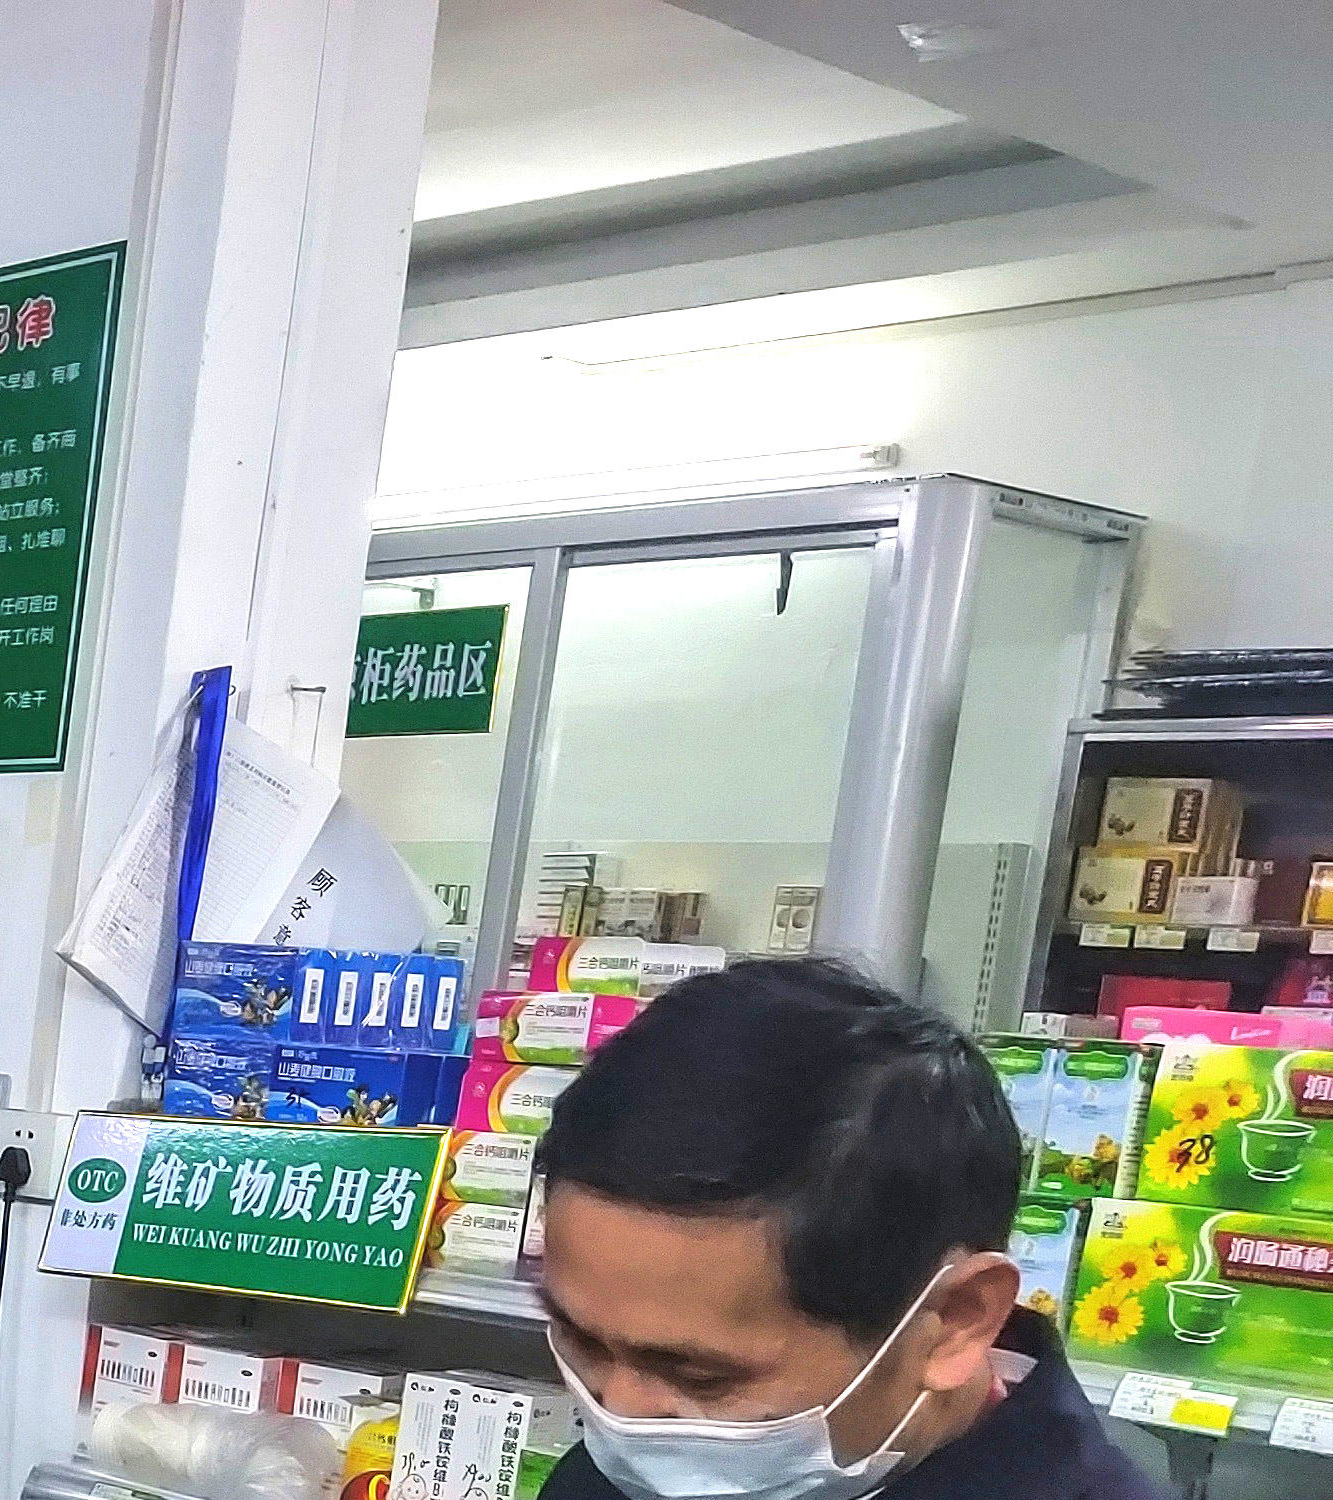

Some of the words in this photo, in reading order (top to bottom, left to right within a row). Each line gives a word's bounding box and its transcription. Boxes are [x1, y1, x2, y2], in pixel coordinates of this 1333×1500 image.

[350, 640, 493, 706] 柜药品区
[76, 1170, 119, 1193] OTC
[141, 1152, 424, 1232] 维矿物质用药
[60, 1208, 119, 1232] 非处方药
[133, 1223, 167, 1245] WEI
[168, 1226, 232, 1252] KUANG
[235, 1234, 267, 1254] WU
[266, 1237, 300, 1259] ZHI
[304, 1239, 358, 1265] YONG
[363, 1245, 404, 1268] YAO
